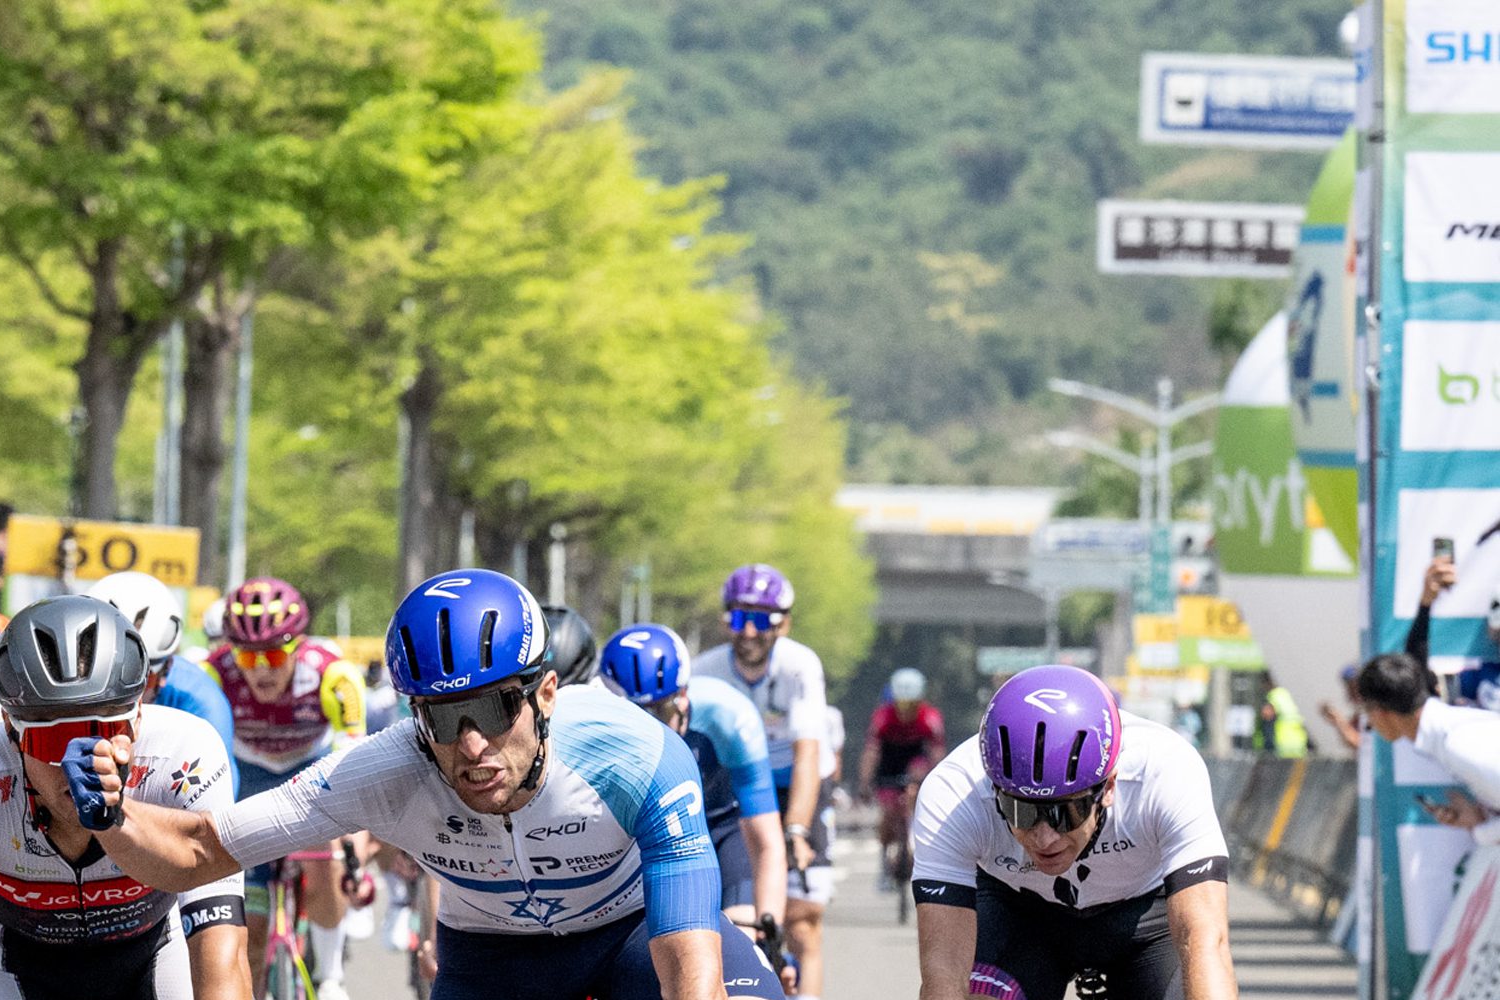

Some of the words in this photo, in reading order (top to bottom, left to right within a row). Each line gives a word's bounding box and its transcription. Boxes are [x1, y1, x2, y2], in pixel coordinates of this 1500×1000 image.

[467, 817, 481, 825] UCI
[422, 852, 478, 874] ISRAEL
[566, 849, 623, 866] PREMIER
[570, 861, 610, 873] TECH
[191, 905, 233, 927] MJS
